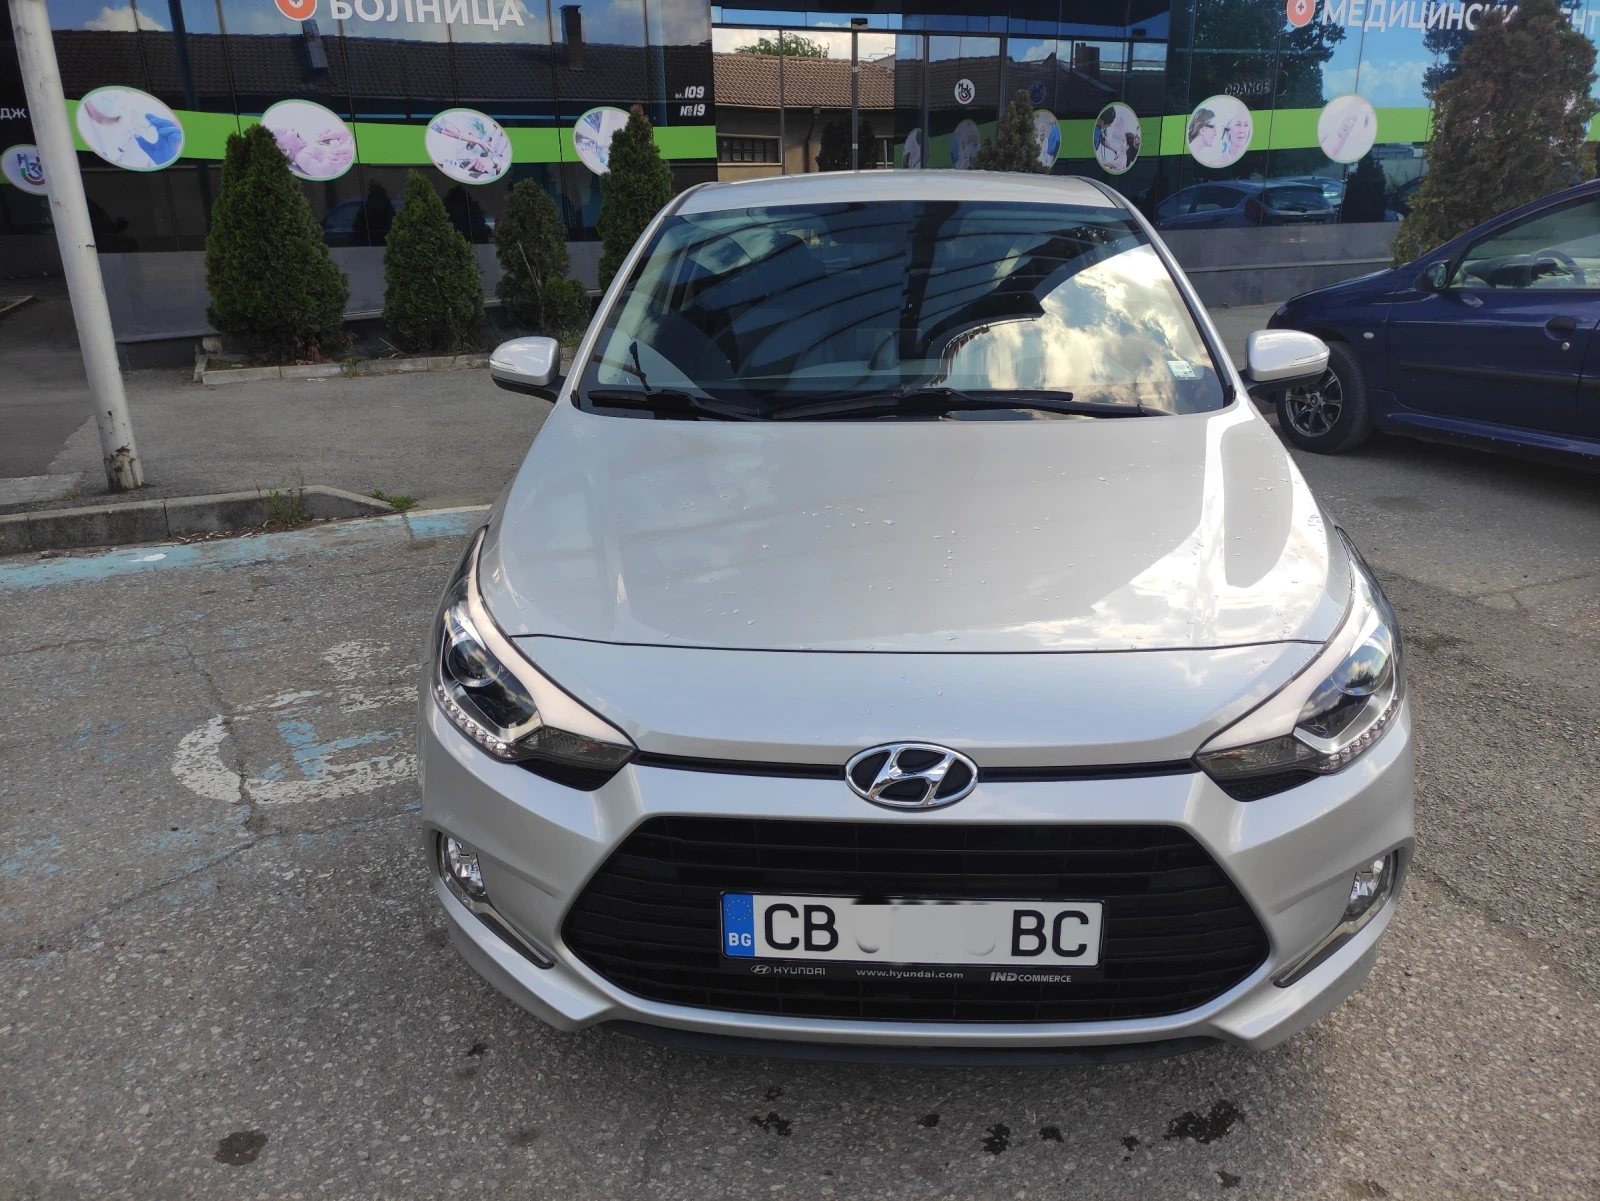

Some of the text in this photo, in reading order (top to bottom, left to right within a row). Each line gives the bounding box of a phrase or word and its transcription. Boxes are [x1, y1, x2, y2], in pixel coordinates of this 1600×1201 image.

[764, 903, 839, 952] CB
[1011, 909, 1089, 958] BC
[728, 932, 752, 947] BG
[773, 966, 826, 976] HYUNDAI
[855, 969, 964, 979] www.hyundai.com
